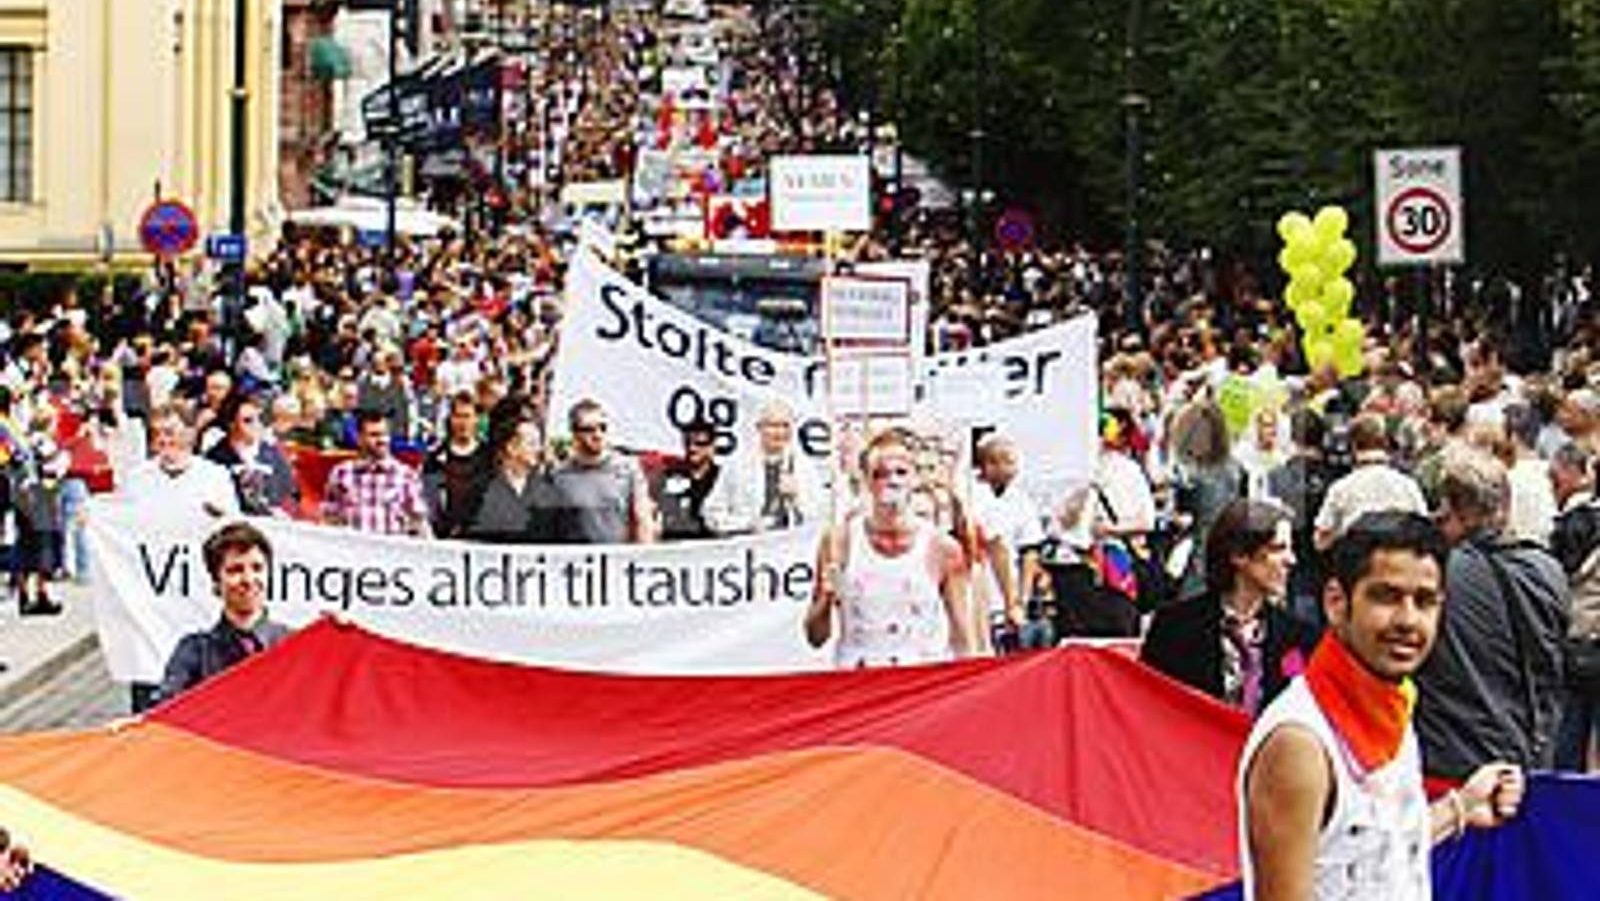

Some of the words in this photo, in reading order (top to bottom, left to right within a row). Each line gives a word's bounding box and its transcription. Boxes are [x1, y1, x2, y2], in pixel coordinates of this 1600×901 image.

[1402, 205, 1441, 236] 30
[595, 283, 776, 385] Stolte
[138, 543, 190, 597] Vi
[427, 552, 547, 607] aldri
[562, 552, 609, 607] til
[624, 548, 814, 607] taushe
